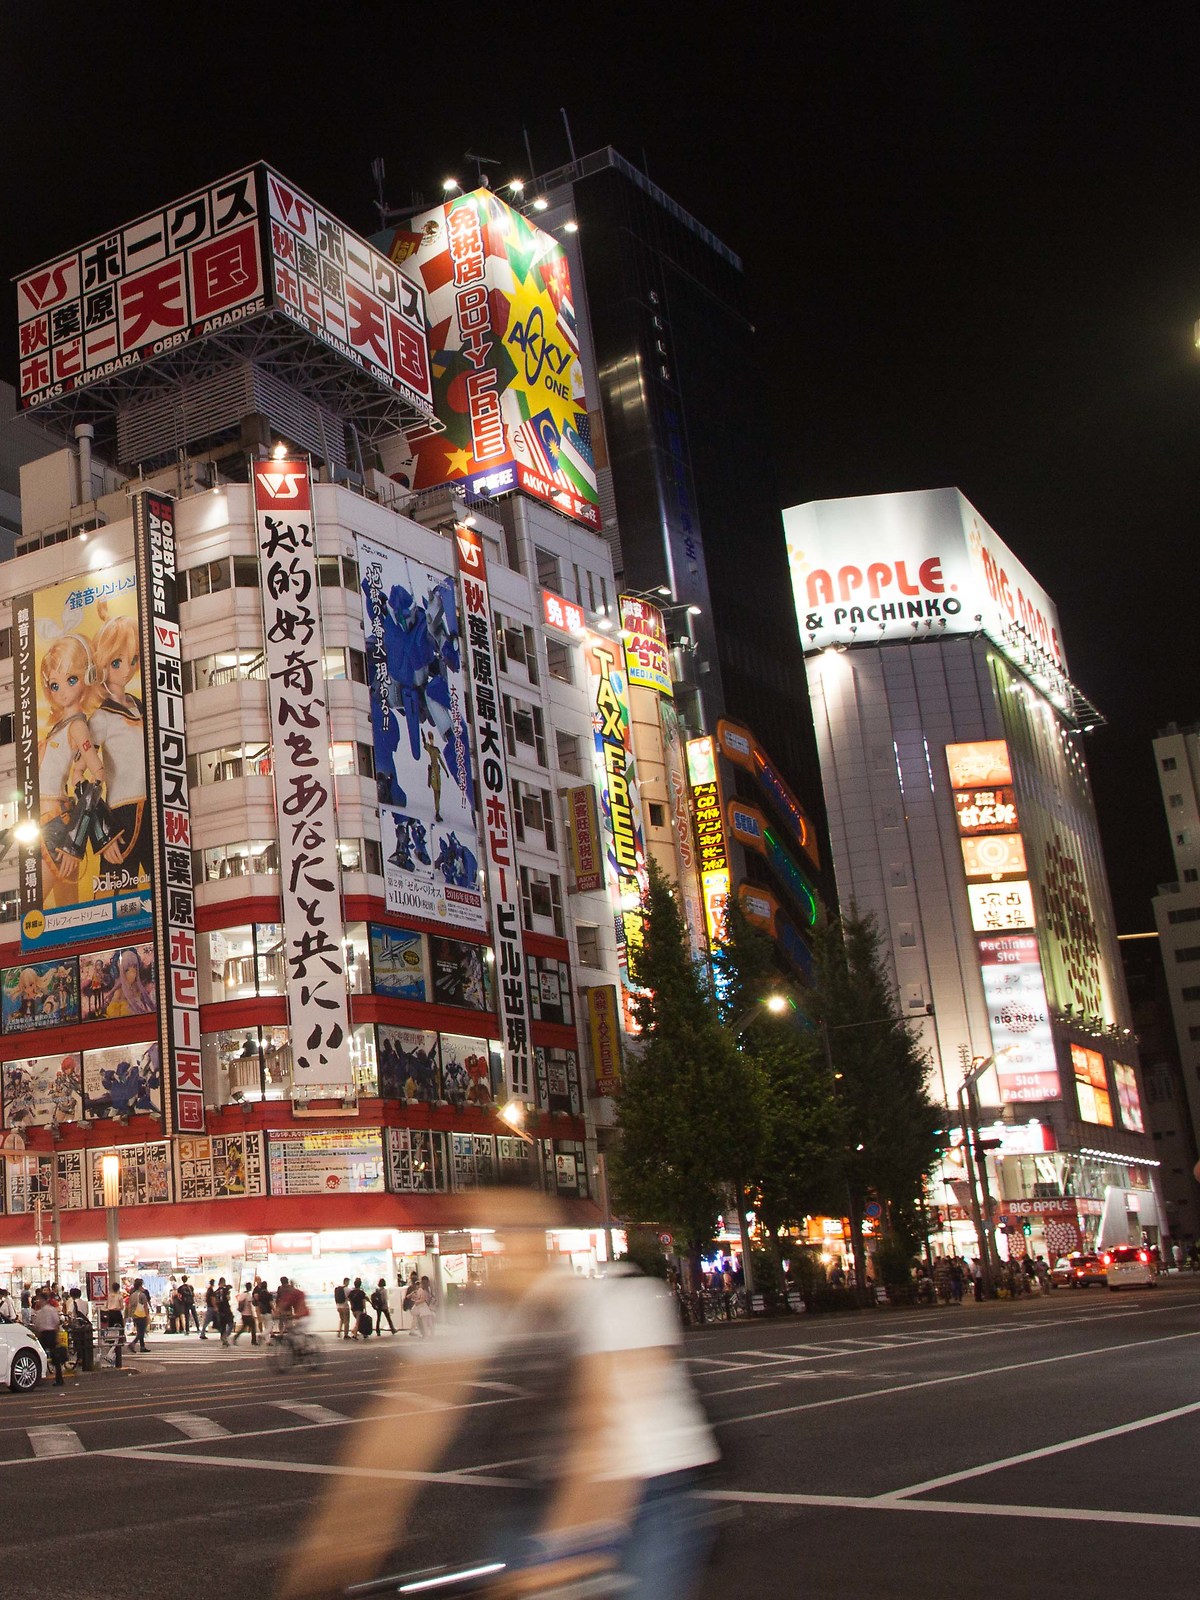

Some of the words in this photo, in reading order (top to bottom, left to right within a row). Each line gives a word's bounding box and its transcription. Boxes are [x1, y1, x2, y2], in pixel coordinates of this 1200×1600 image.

[84, 177, 256, 291] ボークス
[448, 205, 485, 287] 免税店
[272, 226, 343, 300] 秋葉原
[318, 219, 423, 325] ボークス
[120, 224, 260, 350] 天国
[276, 269, 345, 329] ホビー
[20, 286, 115, 356] 秋葉原
[346, 279, 429, 396] 天国
[457, 288, 492, 369] DUTY
[66, 351, 140, 391] AKIHABARA
[144, 330, 191, 356] HOBBY
[194, 298, 266, 337] PARADISE
[21, 336, 116, 393] ホビー
[545, 375, 569, 402] ONE
[467, 369, 505, 462] FREE
[522, 471, 550, 496] AKKY
[149, 501, 166, 614] PARADISE
[161, 502, 176, 582] HOBBY
[981, 546, 1015, 621] BIG
[547, 597, 581, 633] 免税
[805, 612, 824, 630] &
[834, 598, 961, 625] PACHINKO
[630, 668, 653, 680] MEDIA
[592, 647, 624, 745] TAX
[603, 742, 638, 868] FREE
[697, 796, 716, 808] CD
[698, 820, 722, 833] アニメ
[47, 909, 109, 928] ドルフィードリーム
[120, 903, 138, 914] 検索
[981, 938, 1034, 951] Pachinko
[997, 952, 1021, 962] Slot
[995, 1015, 1012, 1025] BIG
[1015, 1013, 1045, 1023] APPLE
[1003, 1087, 1057, 1100] Pachinko
[1015, 1075, 1041, 1086] Slot
[181, 1139, 210, 1159] 3F
[453, 1137, 472, 1155] 5F
[181, 1160, 211, 1178] 食玩
[1009, 1201, 1031, 1213] BIG
